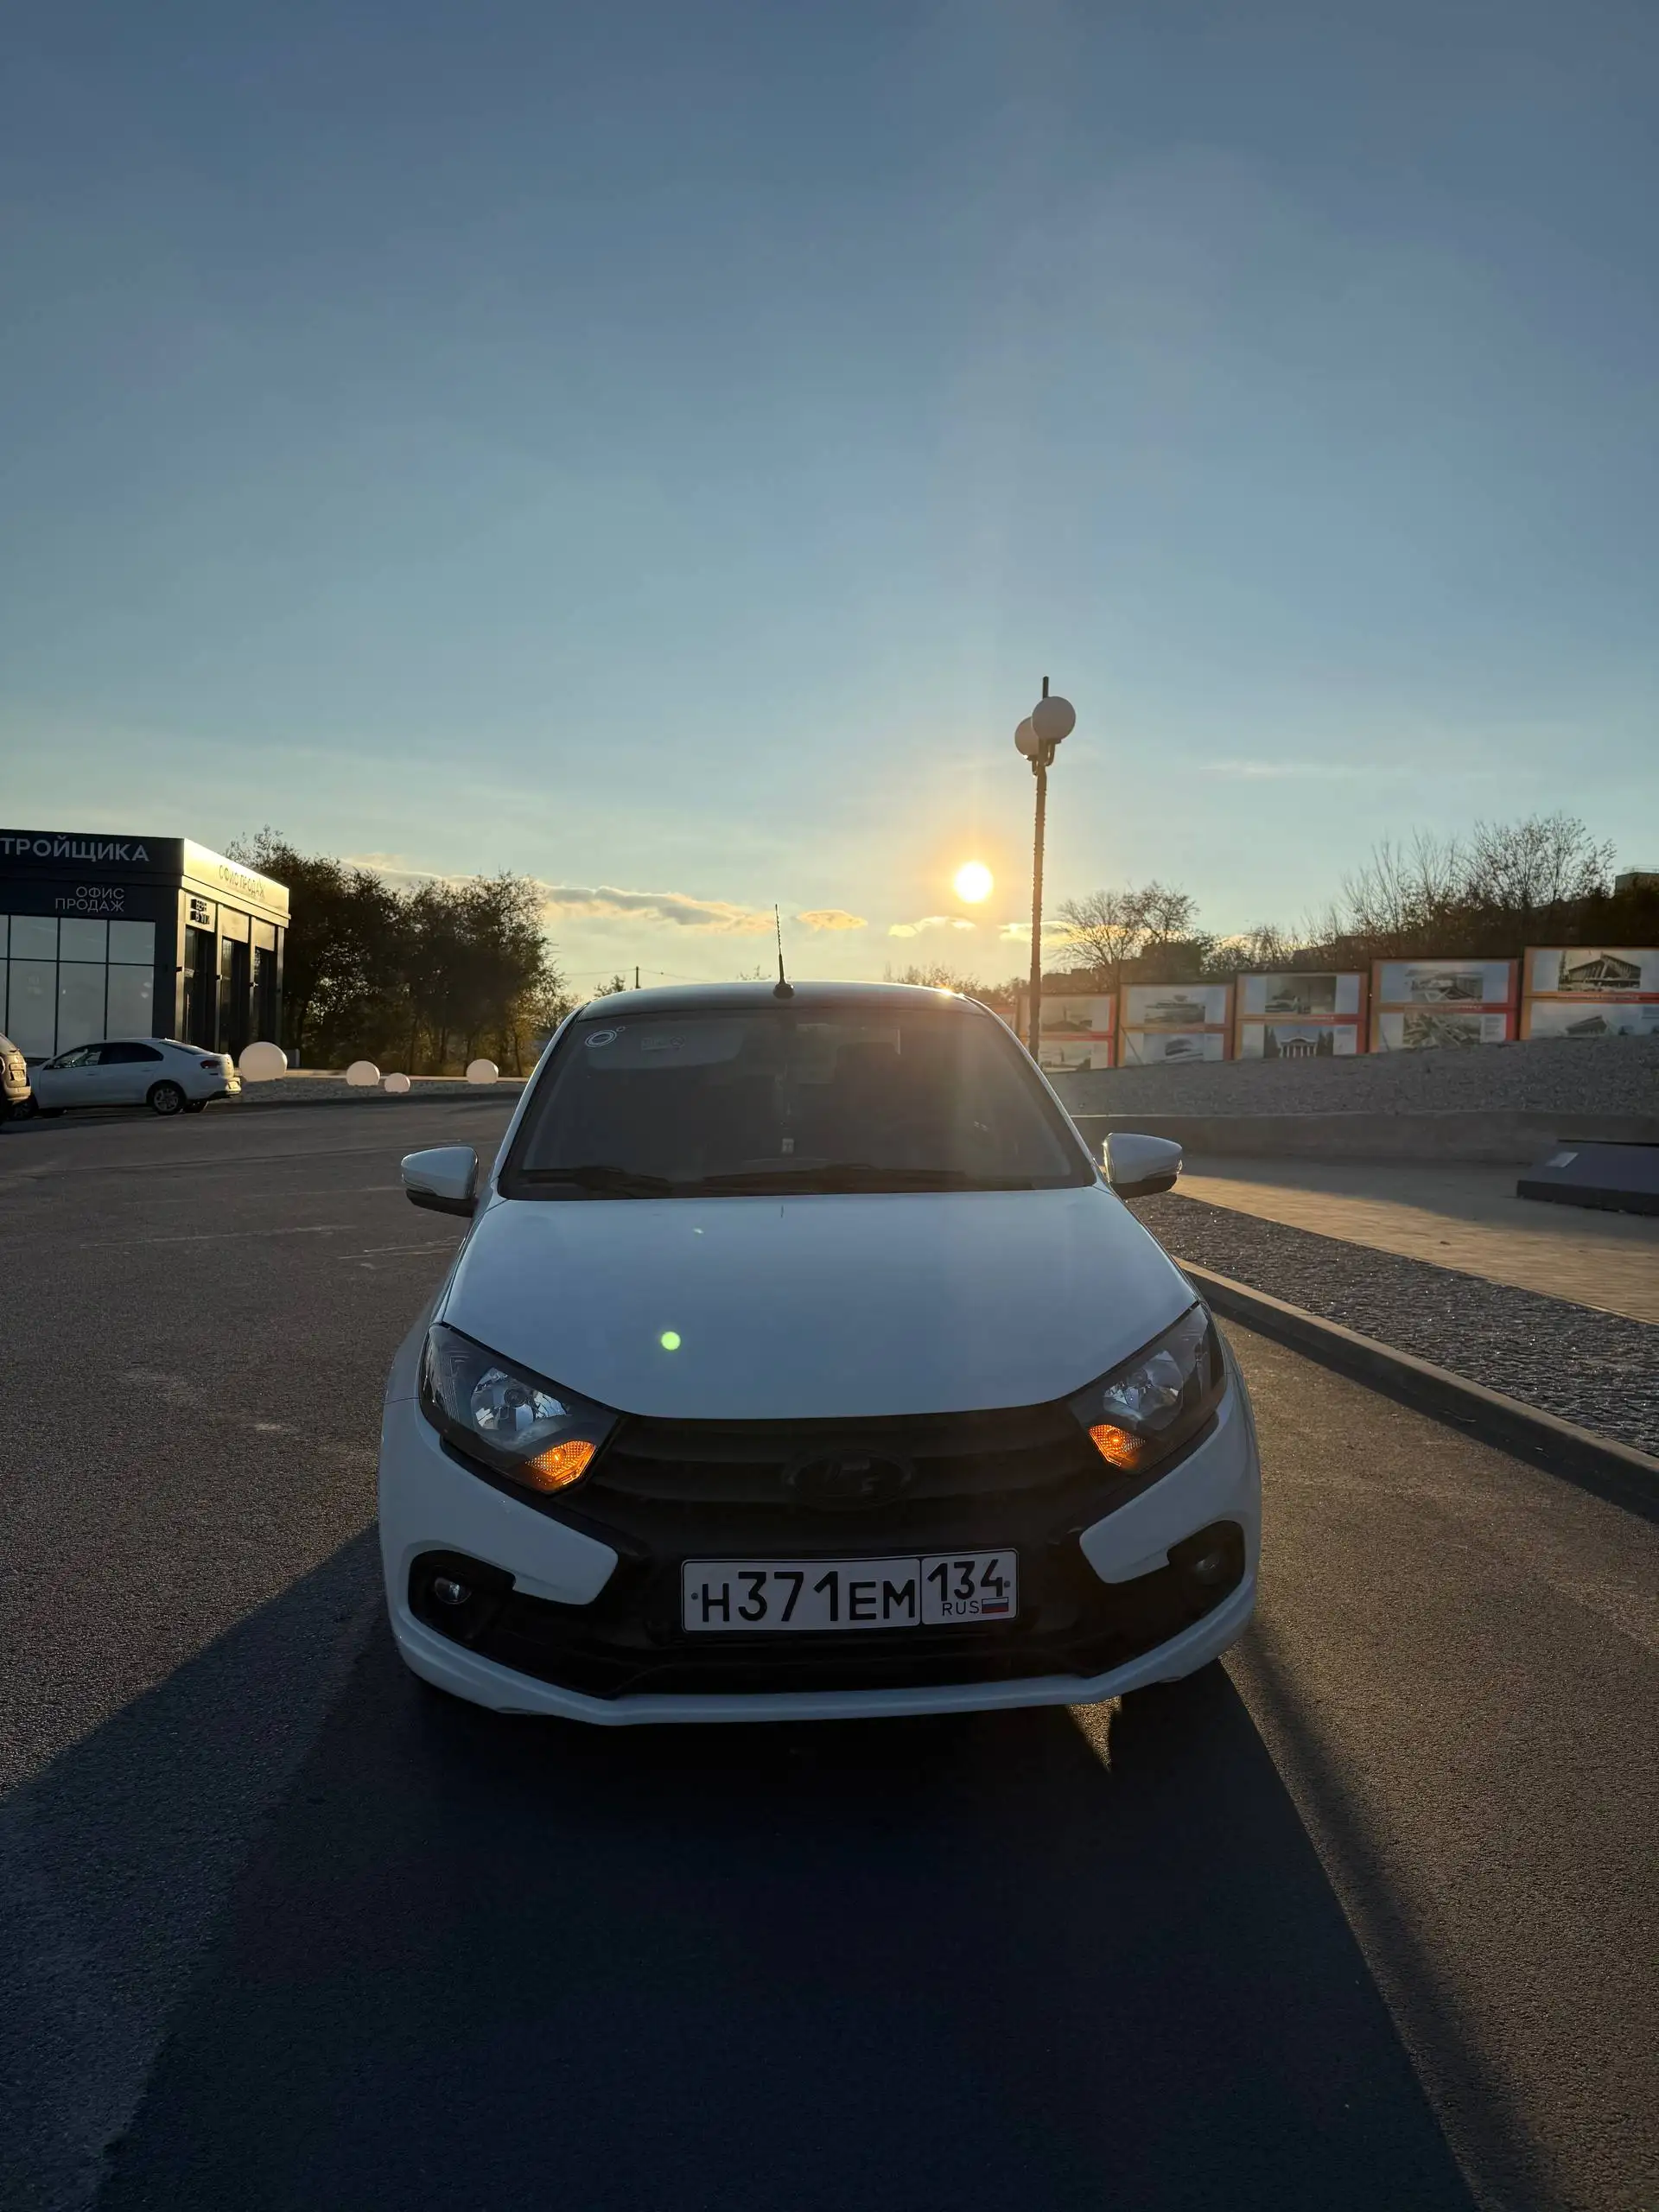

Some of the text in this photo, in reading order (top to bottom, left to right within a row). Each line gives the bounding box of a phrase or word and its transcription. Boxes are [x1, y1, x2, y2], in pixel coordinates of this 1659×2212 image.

[75, 887, 124, 899] ОФИС
[54, 898, 124, 912] ПРОДАЖ
[926, 1559, 1004, 1601] 134
[702, 1571, 916, 1623] Н371ЕМ
[942, 1600, 980, 1616] RUS
